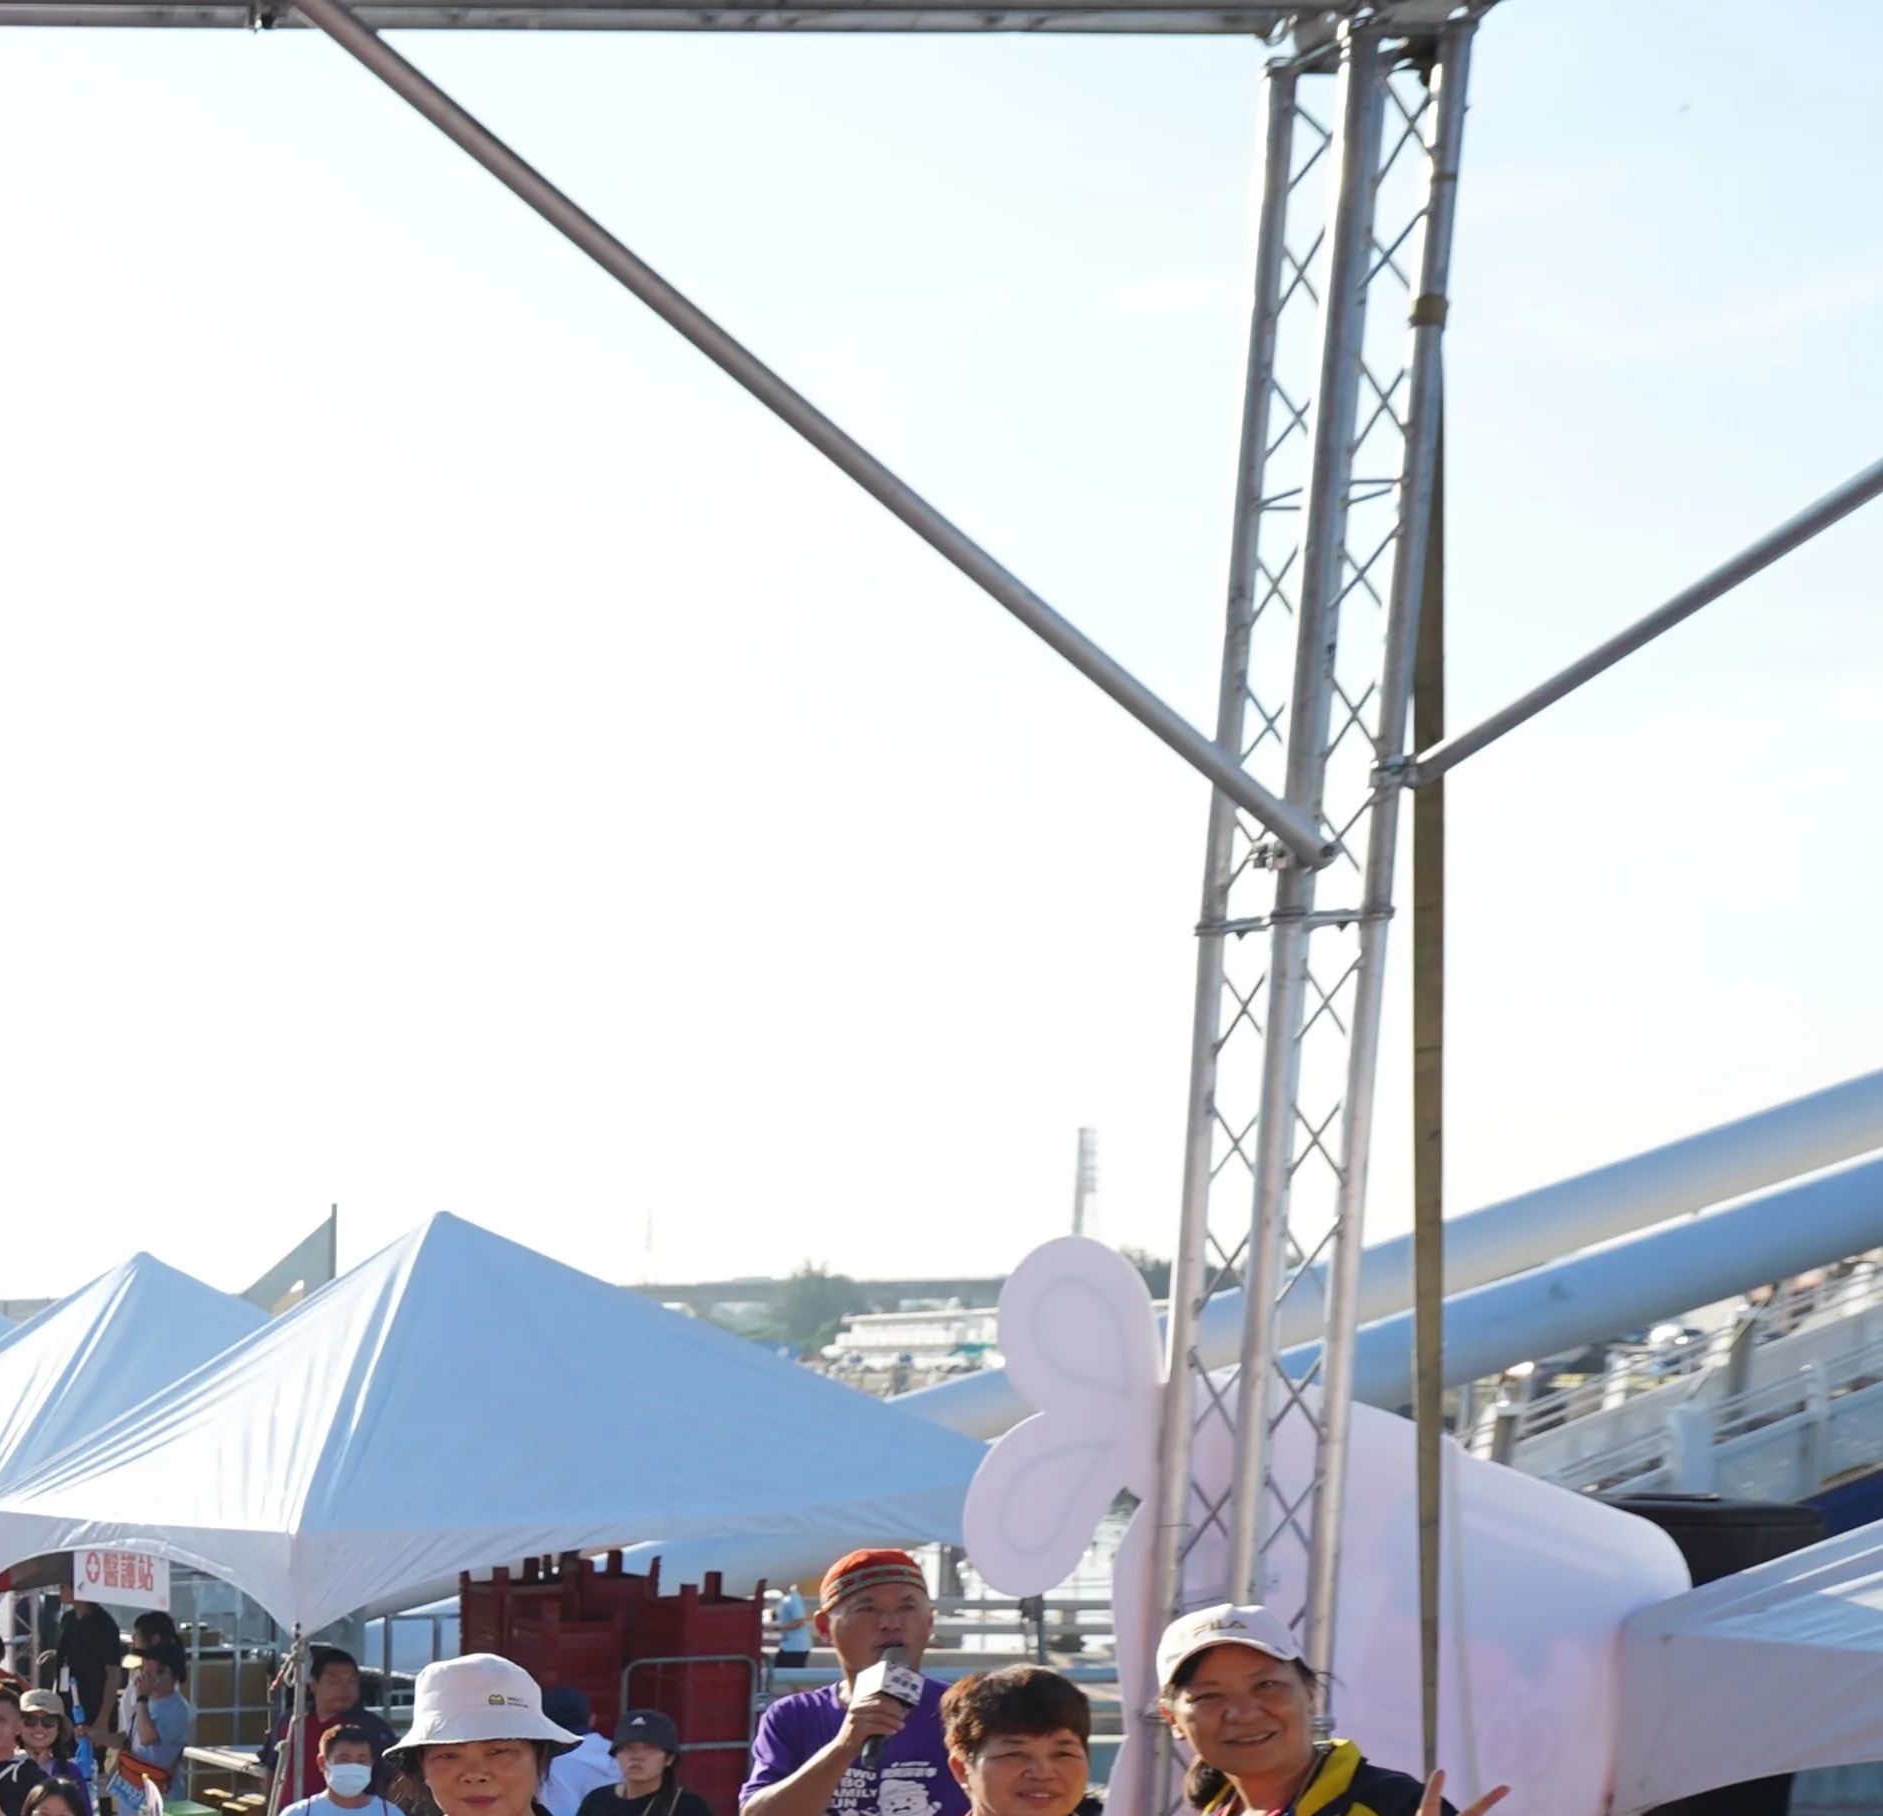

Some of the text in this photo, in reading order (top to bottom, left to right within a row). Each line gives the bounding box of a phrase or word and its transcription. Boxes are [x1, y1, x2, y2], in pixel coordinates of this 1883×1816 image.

[103, 1552, 154, 1591] 醫護站
[833, 1788, 879, 1798] AMILY
